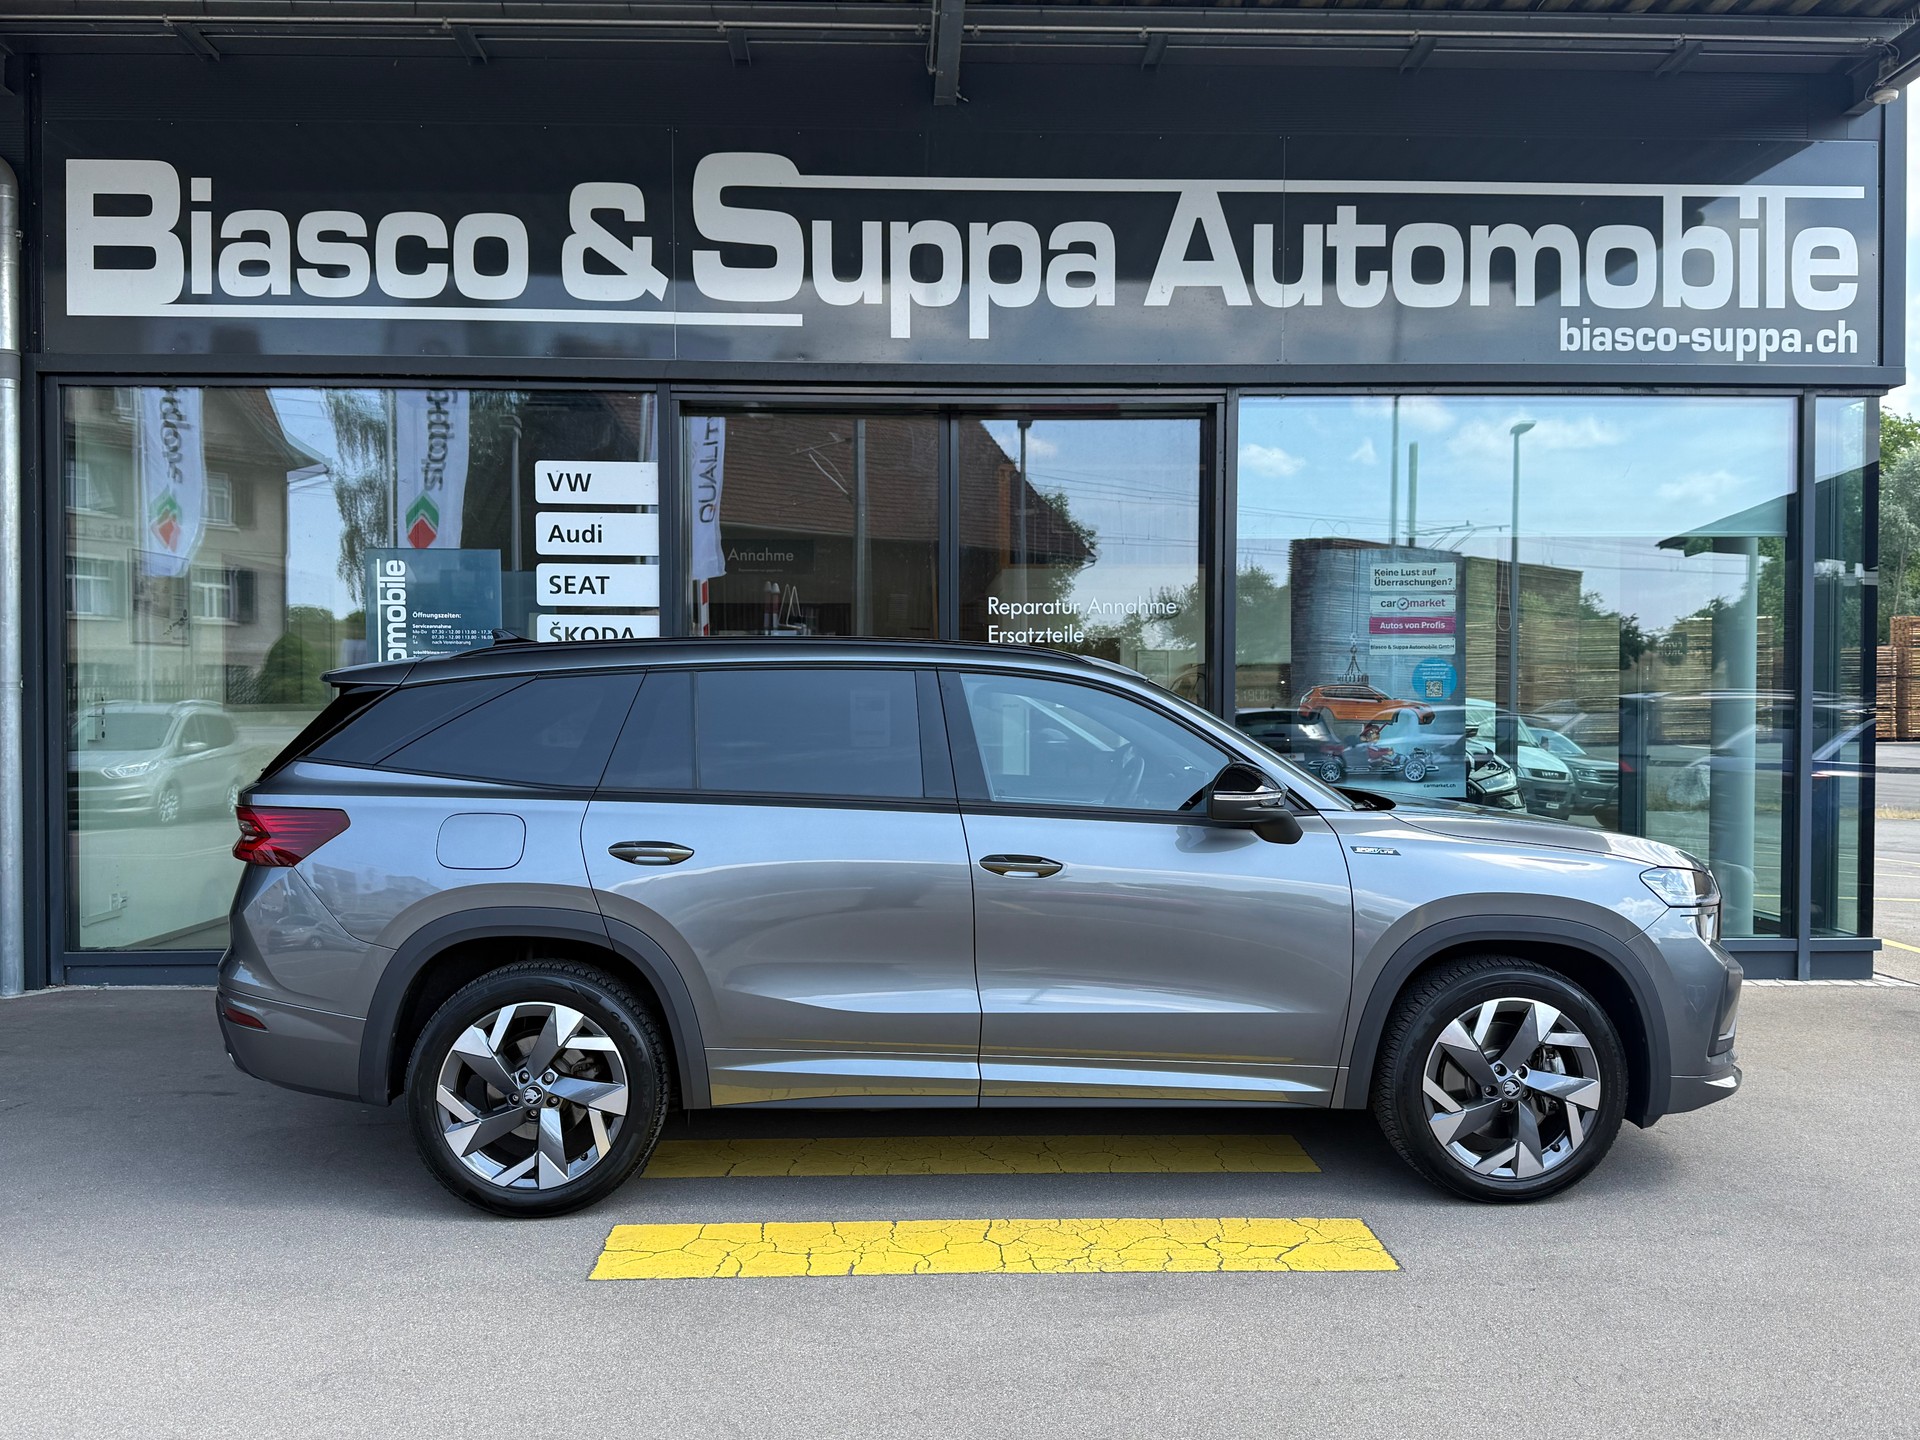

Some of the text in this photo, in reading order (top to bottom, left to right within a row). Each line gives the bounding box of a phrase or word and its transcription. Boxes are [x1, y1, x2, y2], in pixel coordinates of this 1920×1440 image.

[65, 152, 1860, 340] Biasco & Suppa Automobile
[1559, 318, 1859, 362] biasco-suppa.ch
[698, 416, 719, 523] QUALIT
[547, 472, 592, 492] VW
[547, 524, 603, 543] Audi
[727, 547, 795, 562] Annahme
[1374, 567, 1437, 576] Keine Lust auf
[548, 575, 610, 595] SEAT
[1374, 576, 1453, 587] Überraschungen?
[412, 611, 462, 620] Öffnungszeiten:
[988, 596, 1178, 619] Reparatur Annahme
[549, 621, 635, 642] ŠKODA
[988, 625, 1084, 643] Ersatzteile
[1421, 620, 1446, 629] Profis
